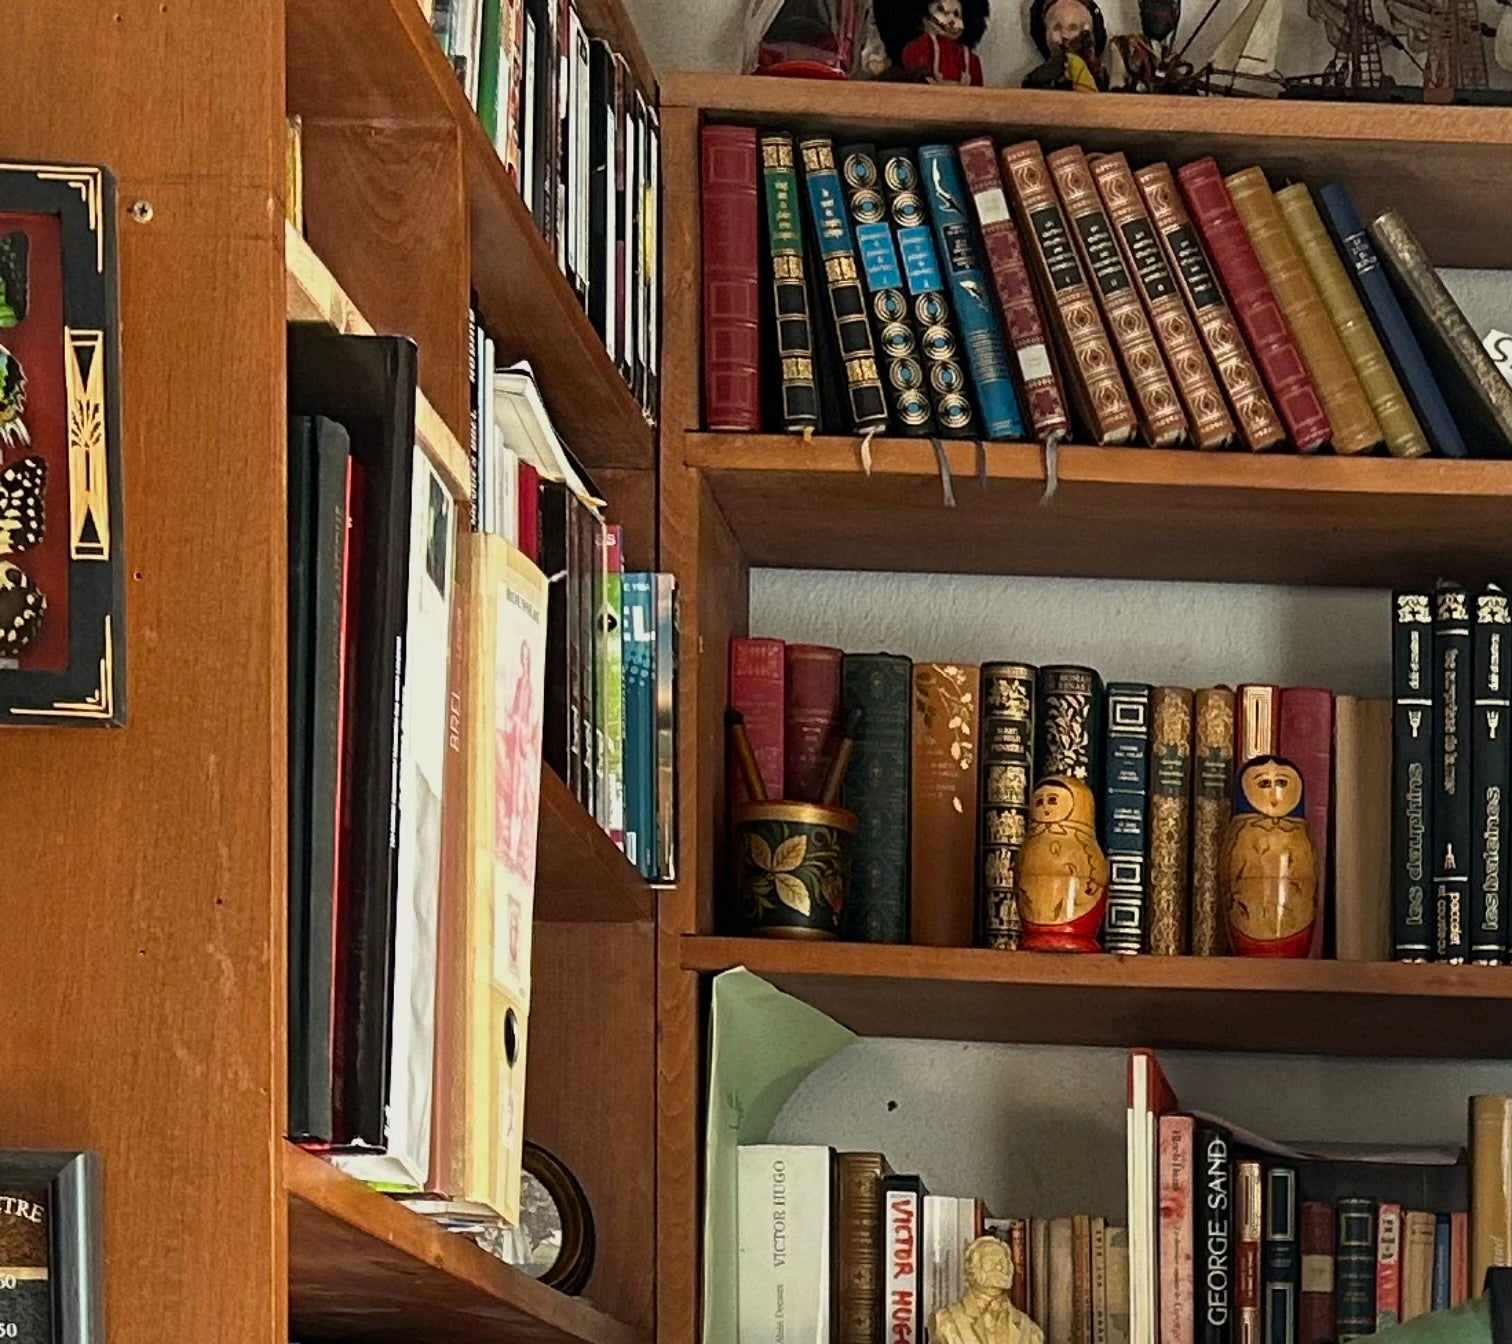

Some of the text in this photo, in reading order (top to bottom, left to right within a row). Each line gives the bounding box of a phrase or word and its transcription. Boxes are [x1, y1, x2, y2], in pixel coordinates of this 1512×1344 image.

[1406, 764, 1425, 924] les dauphins
[1482, 787, 1501, 930] les baleines
[773, 1160, 787, 1267] VICTOR HUGO
[891, 1199, 917, 1280] VICTOR
[1207, 1133, 1229, 1328] GEORGE SAND
